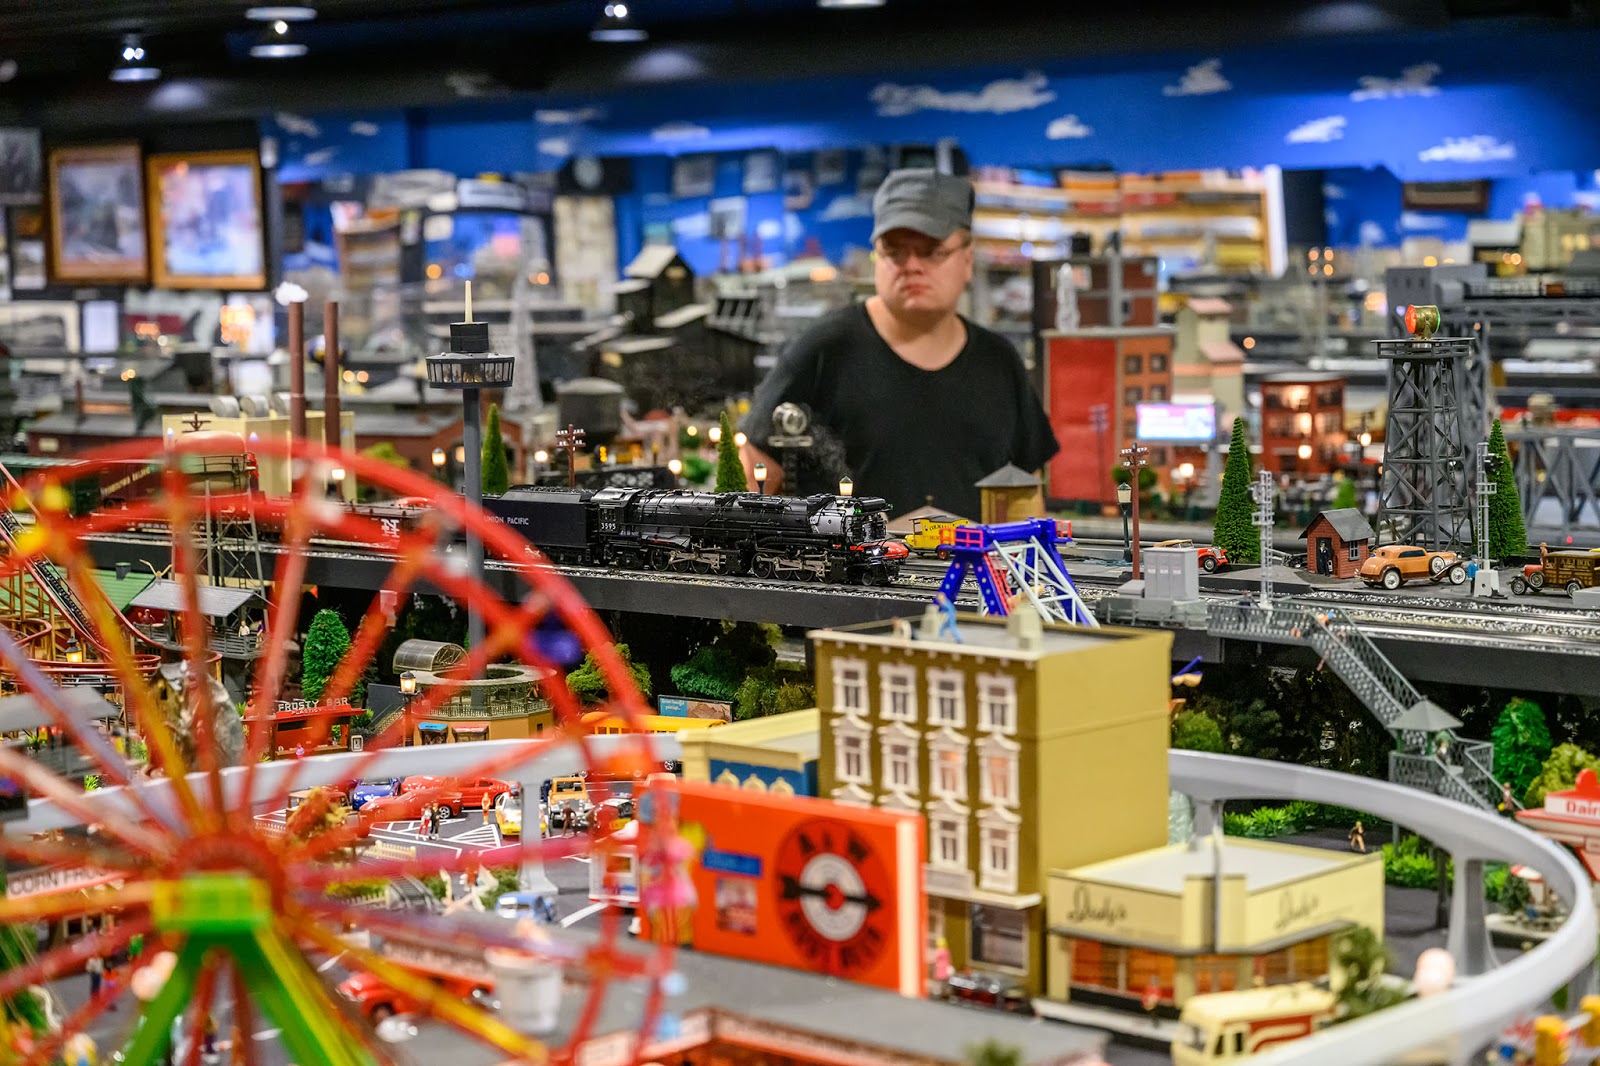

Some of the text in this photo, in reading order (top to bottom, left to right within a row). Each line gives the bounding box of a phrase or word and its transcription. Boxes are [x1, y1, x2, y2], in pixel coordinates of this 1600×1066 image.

[507, 516, 529, 526] PACIFIC
[601, 522, 616, 530] 3595
[278, 699, 319, 713] FROSTY
